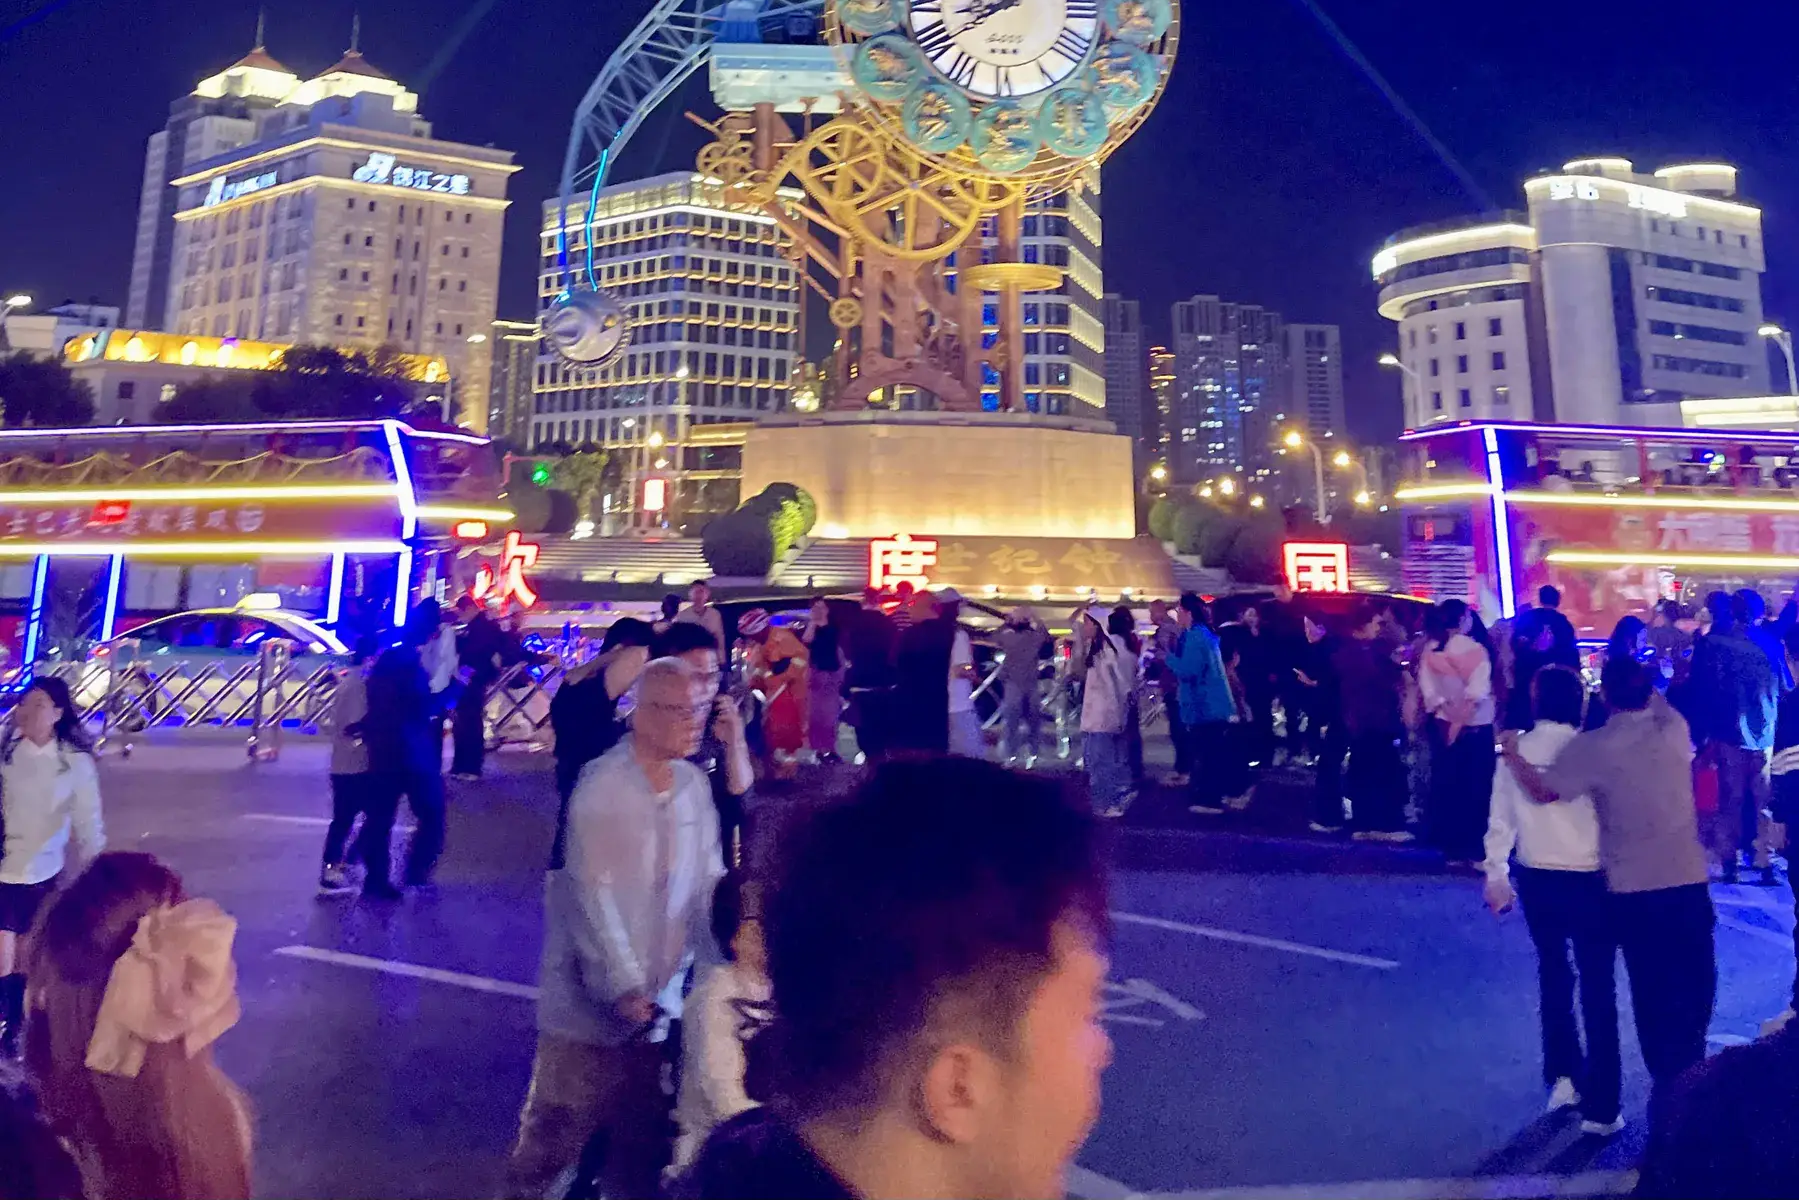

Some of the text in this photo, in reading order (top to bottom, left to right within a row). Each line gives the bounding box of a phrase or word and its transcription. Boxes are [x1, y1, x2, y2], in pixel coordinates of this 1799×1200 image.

[916, 19, 956, 62] VIII
[869, 533, 939, 613] 度
[1283, 541, 1350, 592] 国
